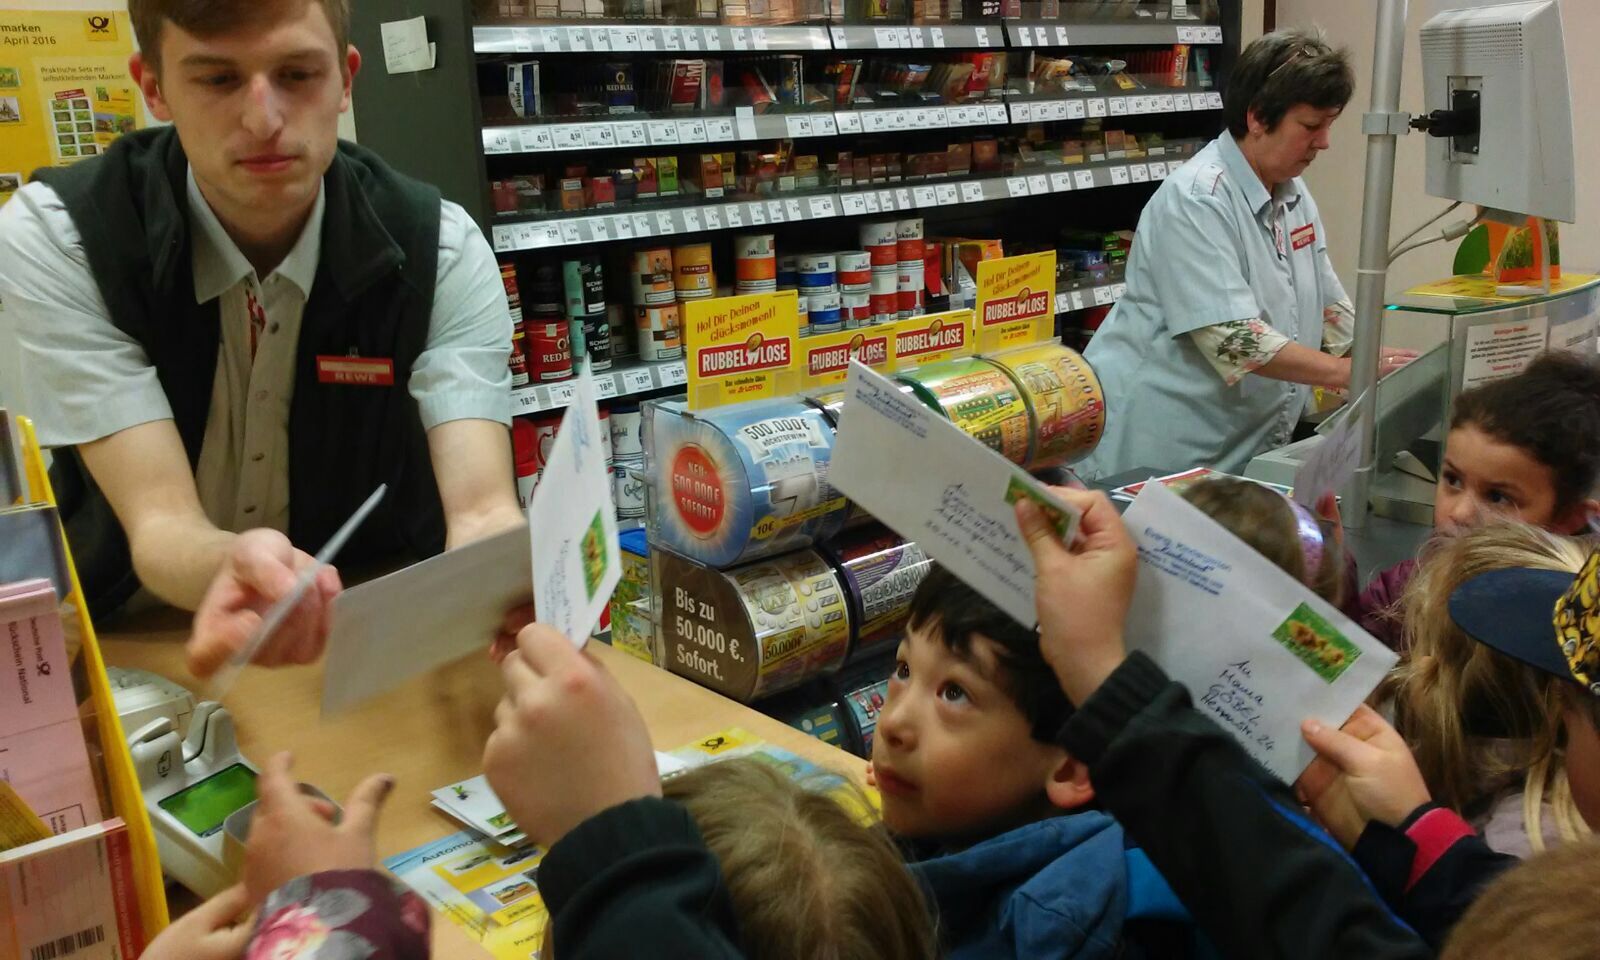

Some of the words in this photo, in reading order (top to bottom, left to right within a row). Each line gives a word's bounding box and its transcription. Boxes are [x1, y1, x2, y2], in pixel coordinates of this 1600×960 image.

[0, 24, 41, 33] marken
[4, 36, 29, 47] April
[33, 36, 57, 45] 2016
[40, 66, 77, 74] Praktische
[43, 74, 97, 82] selbstklebenden
[697, 317, 711, 334] Hol
[713, 314, 727, 327] Dir
[730, 301, 760, 321] Deinen
[985, 301, 1018, 321] RUBBEL
[1026, 295, 1047, 314] LOSE
[710, 305, 776, 342] Glücksmoment!
[896, 333, 930, 354] RUBBEL
[938, 327, 962, 346] LOSE
[542, 352, 561, 363] RED
[702, 348, 748, 373] RUBBEL
[760, 343, 788, 364] LOSE
[811, 349, 850, 371] RUBBEL
[861, 342, 885, 362] LOSE
[334, 372, 378, 382] REWE
[744, 418, 810, 440] 500.000€
[757, 520, 775, 535] 10€
[675, 586, 696, 614] Bis
[699, 600, 715, 623] zu
[675, 615, 726, 654] 50.000
[8, 621, 23, 667] Rückschein
[18, 668, 33, 705] National
[35, 646, 44, 662] Post
[676, 644, 724, 681] Sofort.
